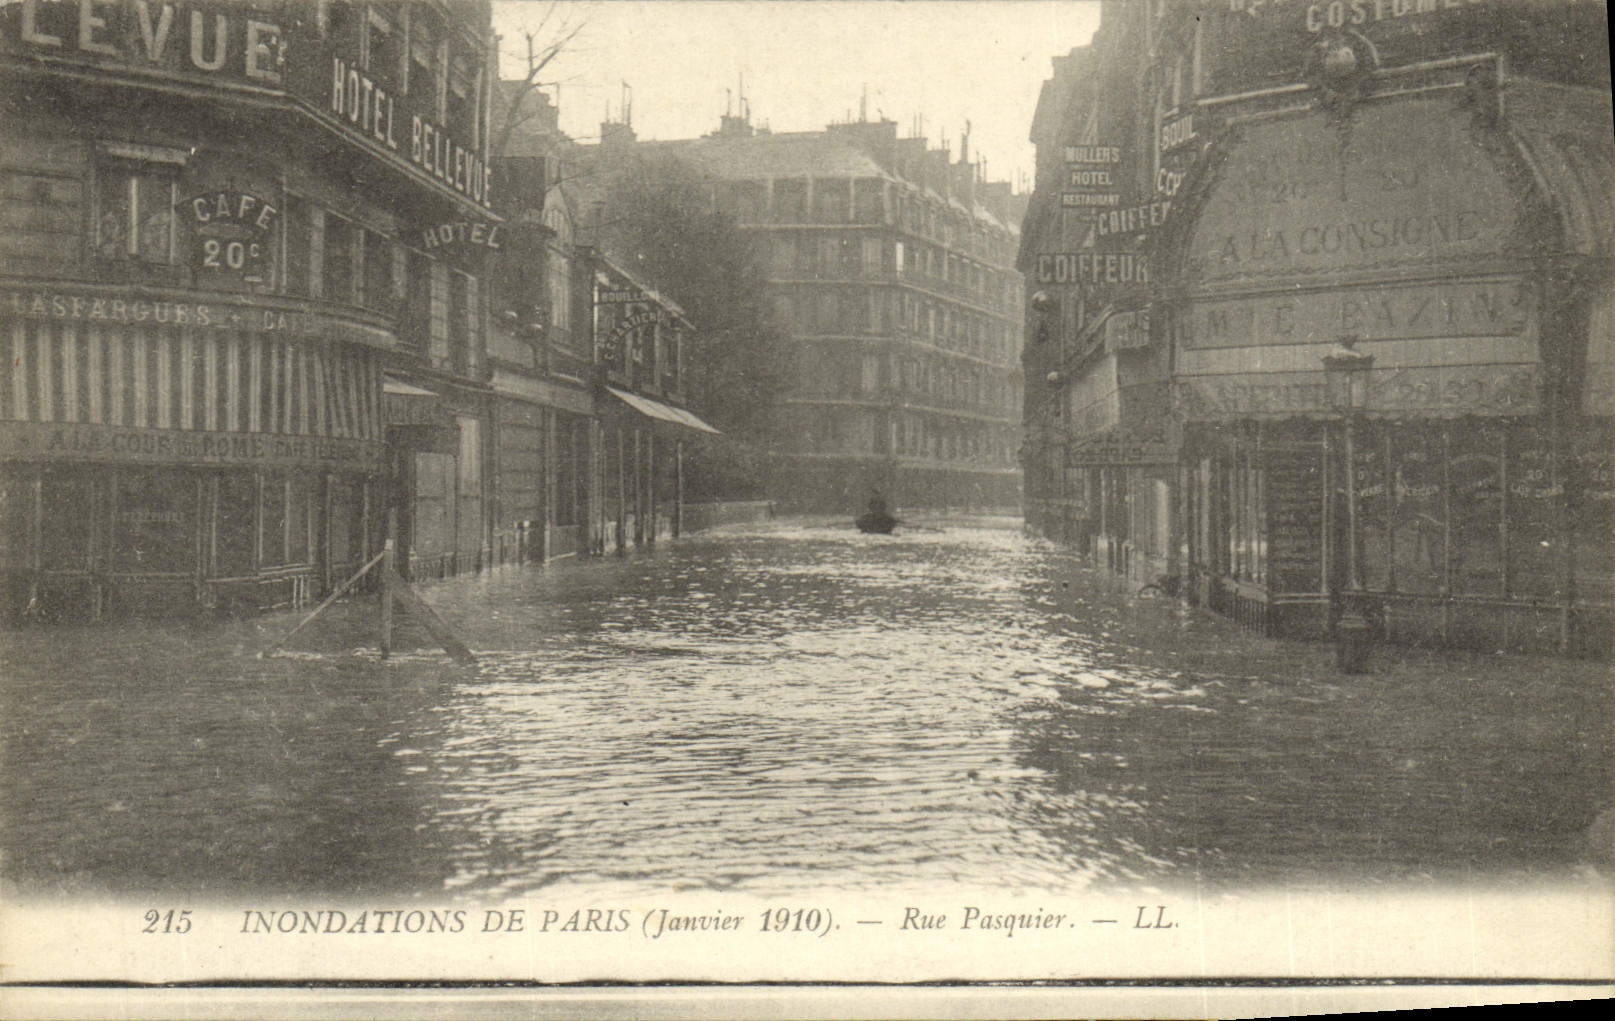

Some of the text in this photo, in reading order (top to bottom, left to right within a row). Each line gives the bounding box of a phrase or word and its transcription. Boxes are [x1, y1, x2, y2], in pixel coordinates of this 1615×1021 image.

[332, 58, 493, 208] HOTEL BELLEVUE
[1071, 171, 1113, 186] HOTEL
[423, 221, 500, 249] HOTEL
[1299, 208, 1484, 256] CONSIGNE
[1038, 254, 1149, 284] COIFFEUR
